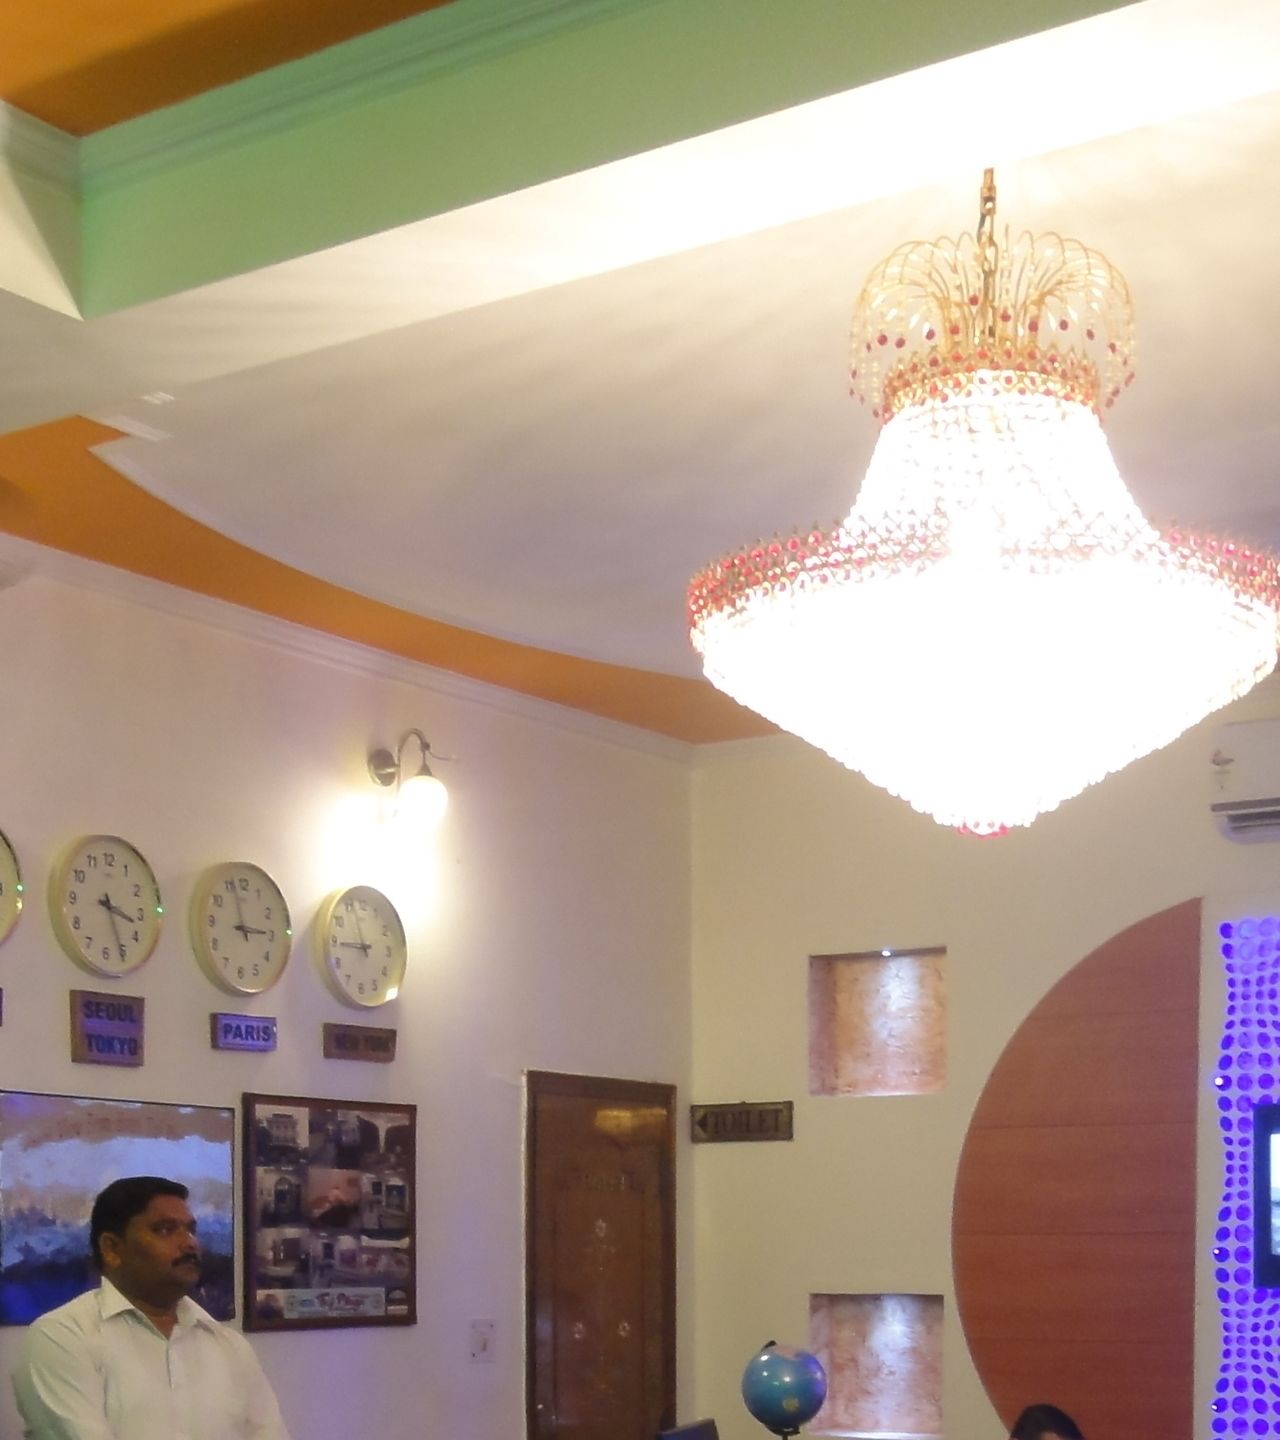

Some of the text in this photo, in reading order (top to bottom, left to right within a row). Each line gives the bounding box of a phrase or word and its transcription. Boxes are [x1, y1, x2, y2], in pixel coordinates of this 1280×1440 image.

[86, 854, 97, 868] 11
[103, 852, 115, 867] 12
[73, 869, 85, 884] 10
[123, 864, 129, 877] 1
[133, 883, 140, 897] 2
[238, 878, 249, 892] 12
[69, 890, 77, 905] 9
[137, 907, 144, 921] 3
[208, 914, 215, 927] 9
[72, 915, 81, 930] 8
[84, 935, 93, 949] 7
[132, 929, 139, 943] 4
[102, 946, 110, 960] 6
[82, 1000, 136, 1023] SEOUL
[223, 1022, 270, 1041] PARIS
[86, 1031, 138, 1056] TOKYO
